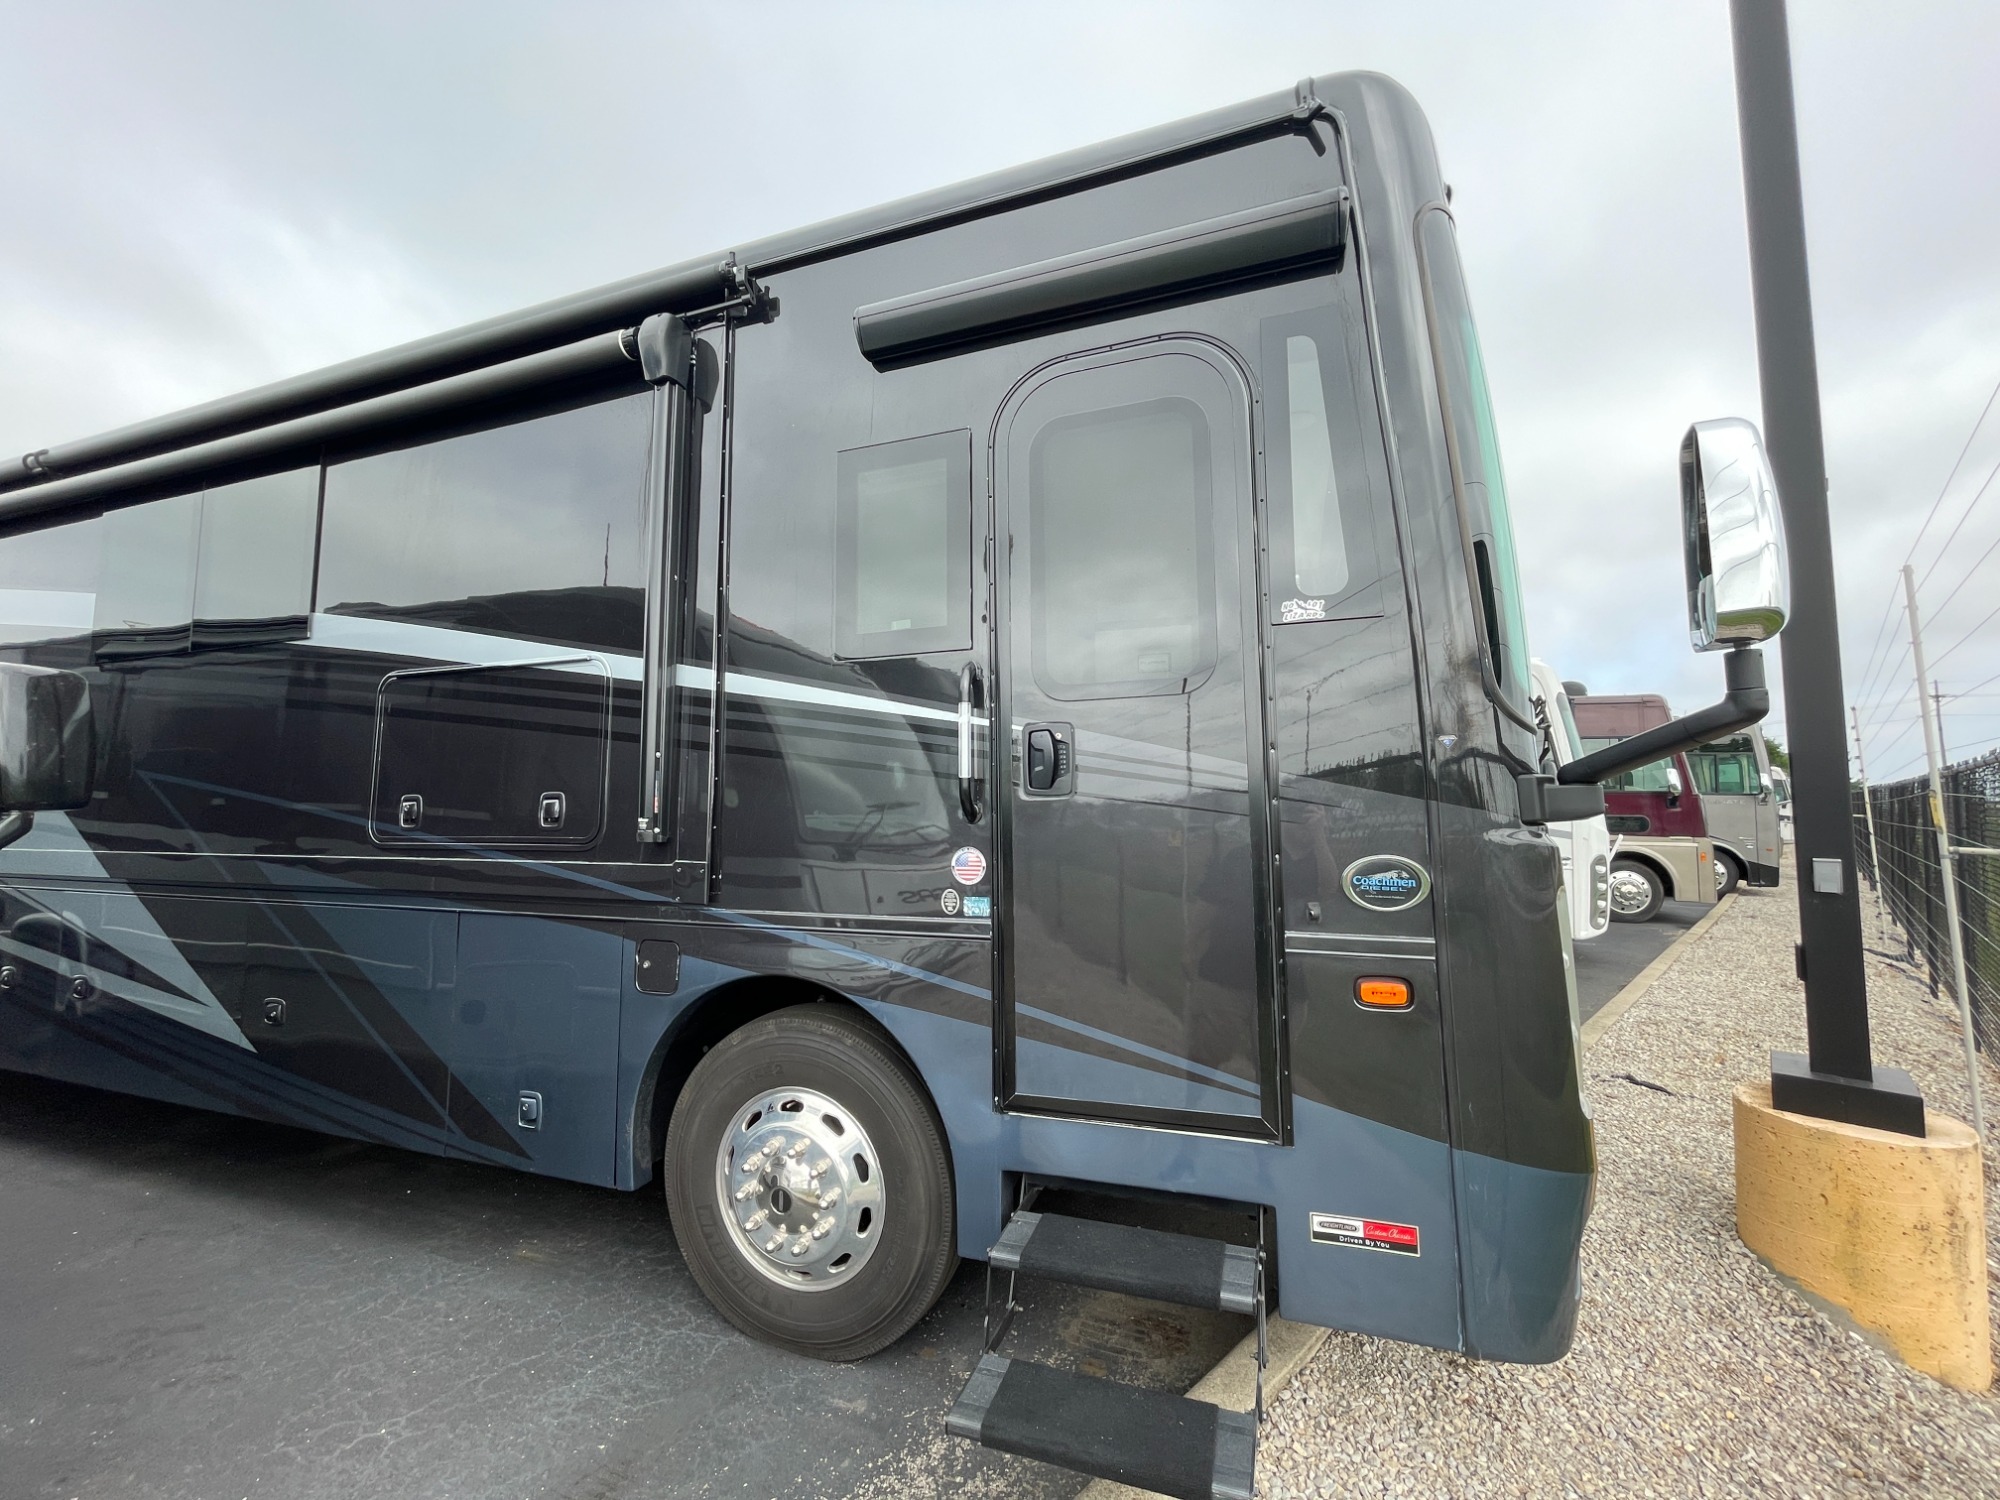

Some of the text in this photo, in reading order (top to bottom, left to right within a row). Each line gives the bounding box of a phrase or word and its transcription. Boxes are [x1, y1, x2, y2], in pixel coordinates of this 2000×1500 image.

[1283, 611, 1324, 621] LIZARDS
[1352, 875, 1417, 888] Coachmen
[1361, 884, 1408, 892] DIESEL
[1320, 1220, 1357, 1232] FREIGHTLINER
[1339, 1235, 1390, 1249] Driven By You
